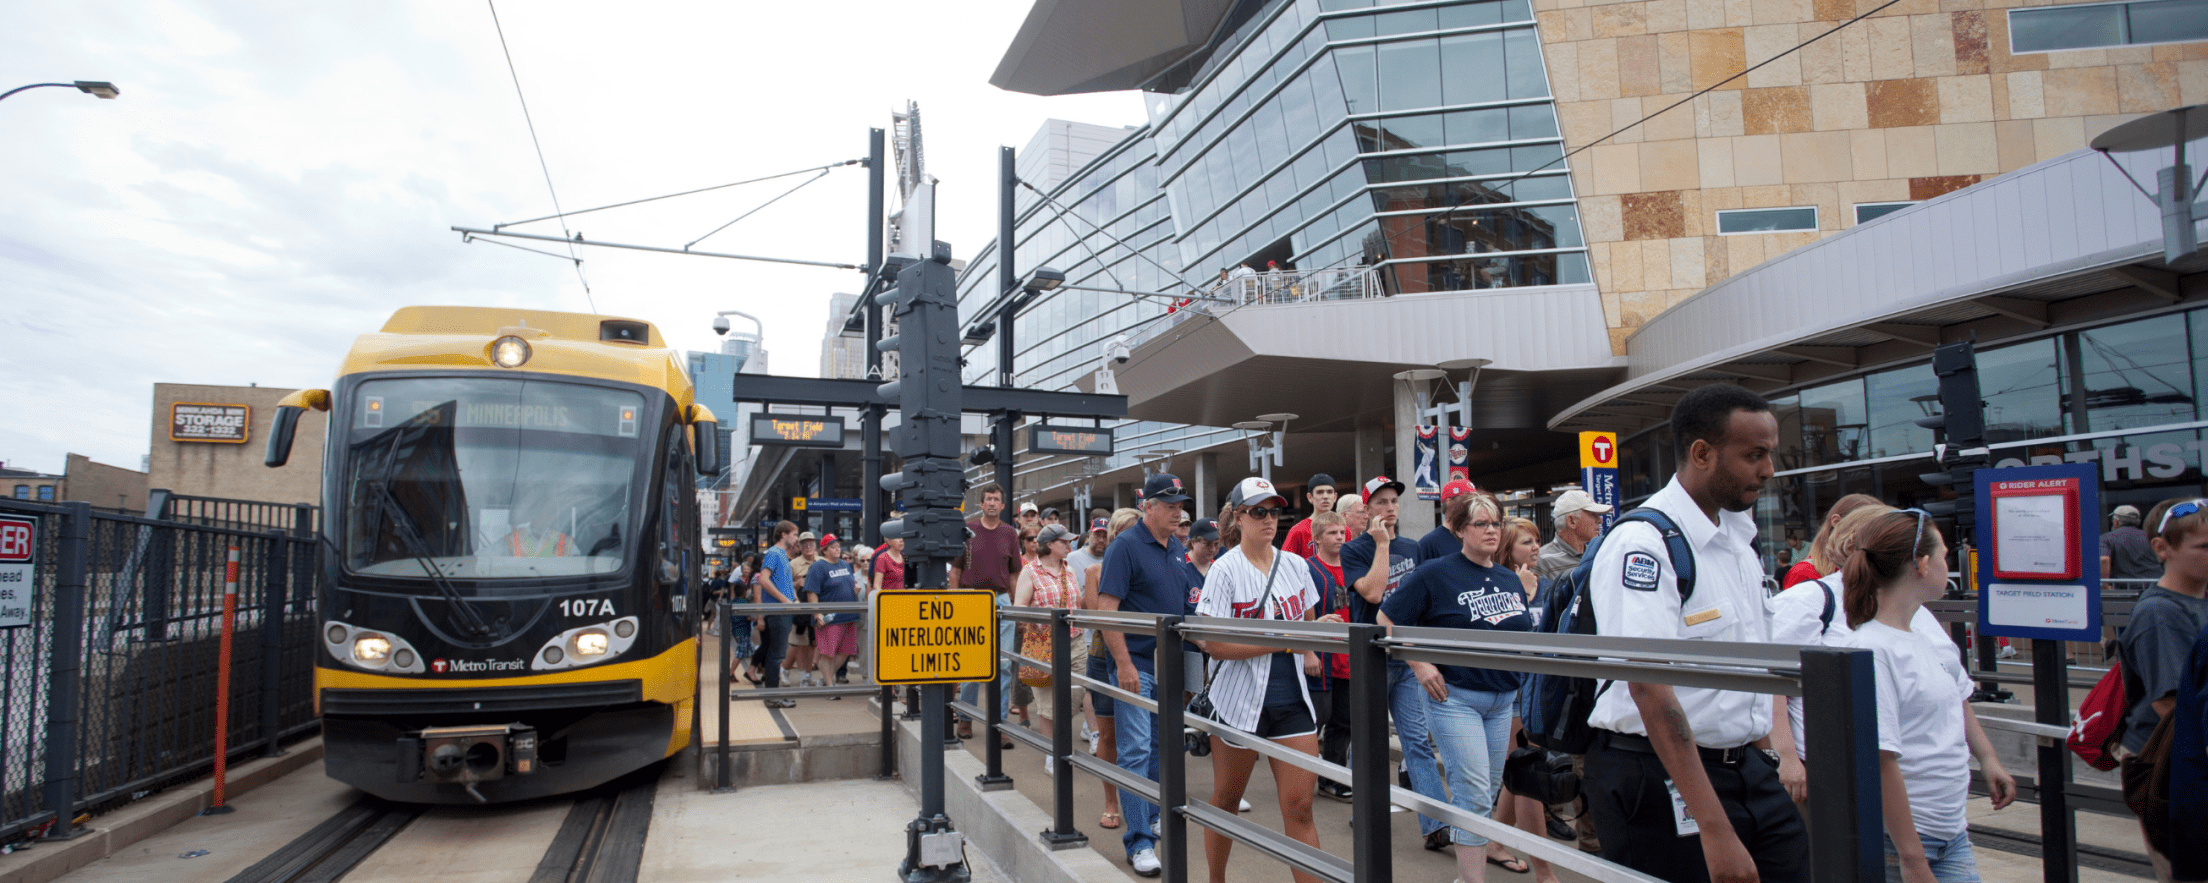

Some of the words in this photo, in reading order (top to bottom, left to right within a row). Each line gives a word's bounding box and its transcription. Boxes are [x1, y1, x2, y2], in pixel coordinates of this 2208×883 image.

[175, 413, 244, 427] STORAGE
[466, 403, 568, 427] MINNEAPOLIS
[2009, 481, 2035, 489] RIDER
[2038, 479, 2068, 488] ALERT
[0, 525, 30, 555] ER
[0, 569, 22, 582] ead
[1627, 571, 1655, 581] Services
[1628, 565, 1655, 576] Security
[559, 599, 615, 618] 107A
[672, 595, 686, 612] 107A
[919, 601, 954, 620] END
[886, 625, 985, 647] INTERLOCKING
[449, 658, 524, 672] MetroTransit
[911, 652, 960, 673] LIMITS
